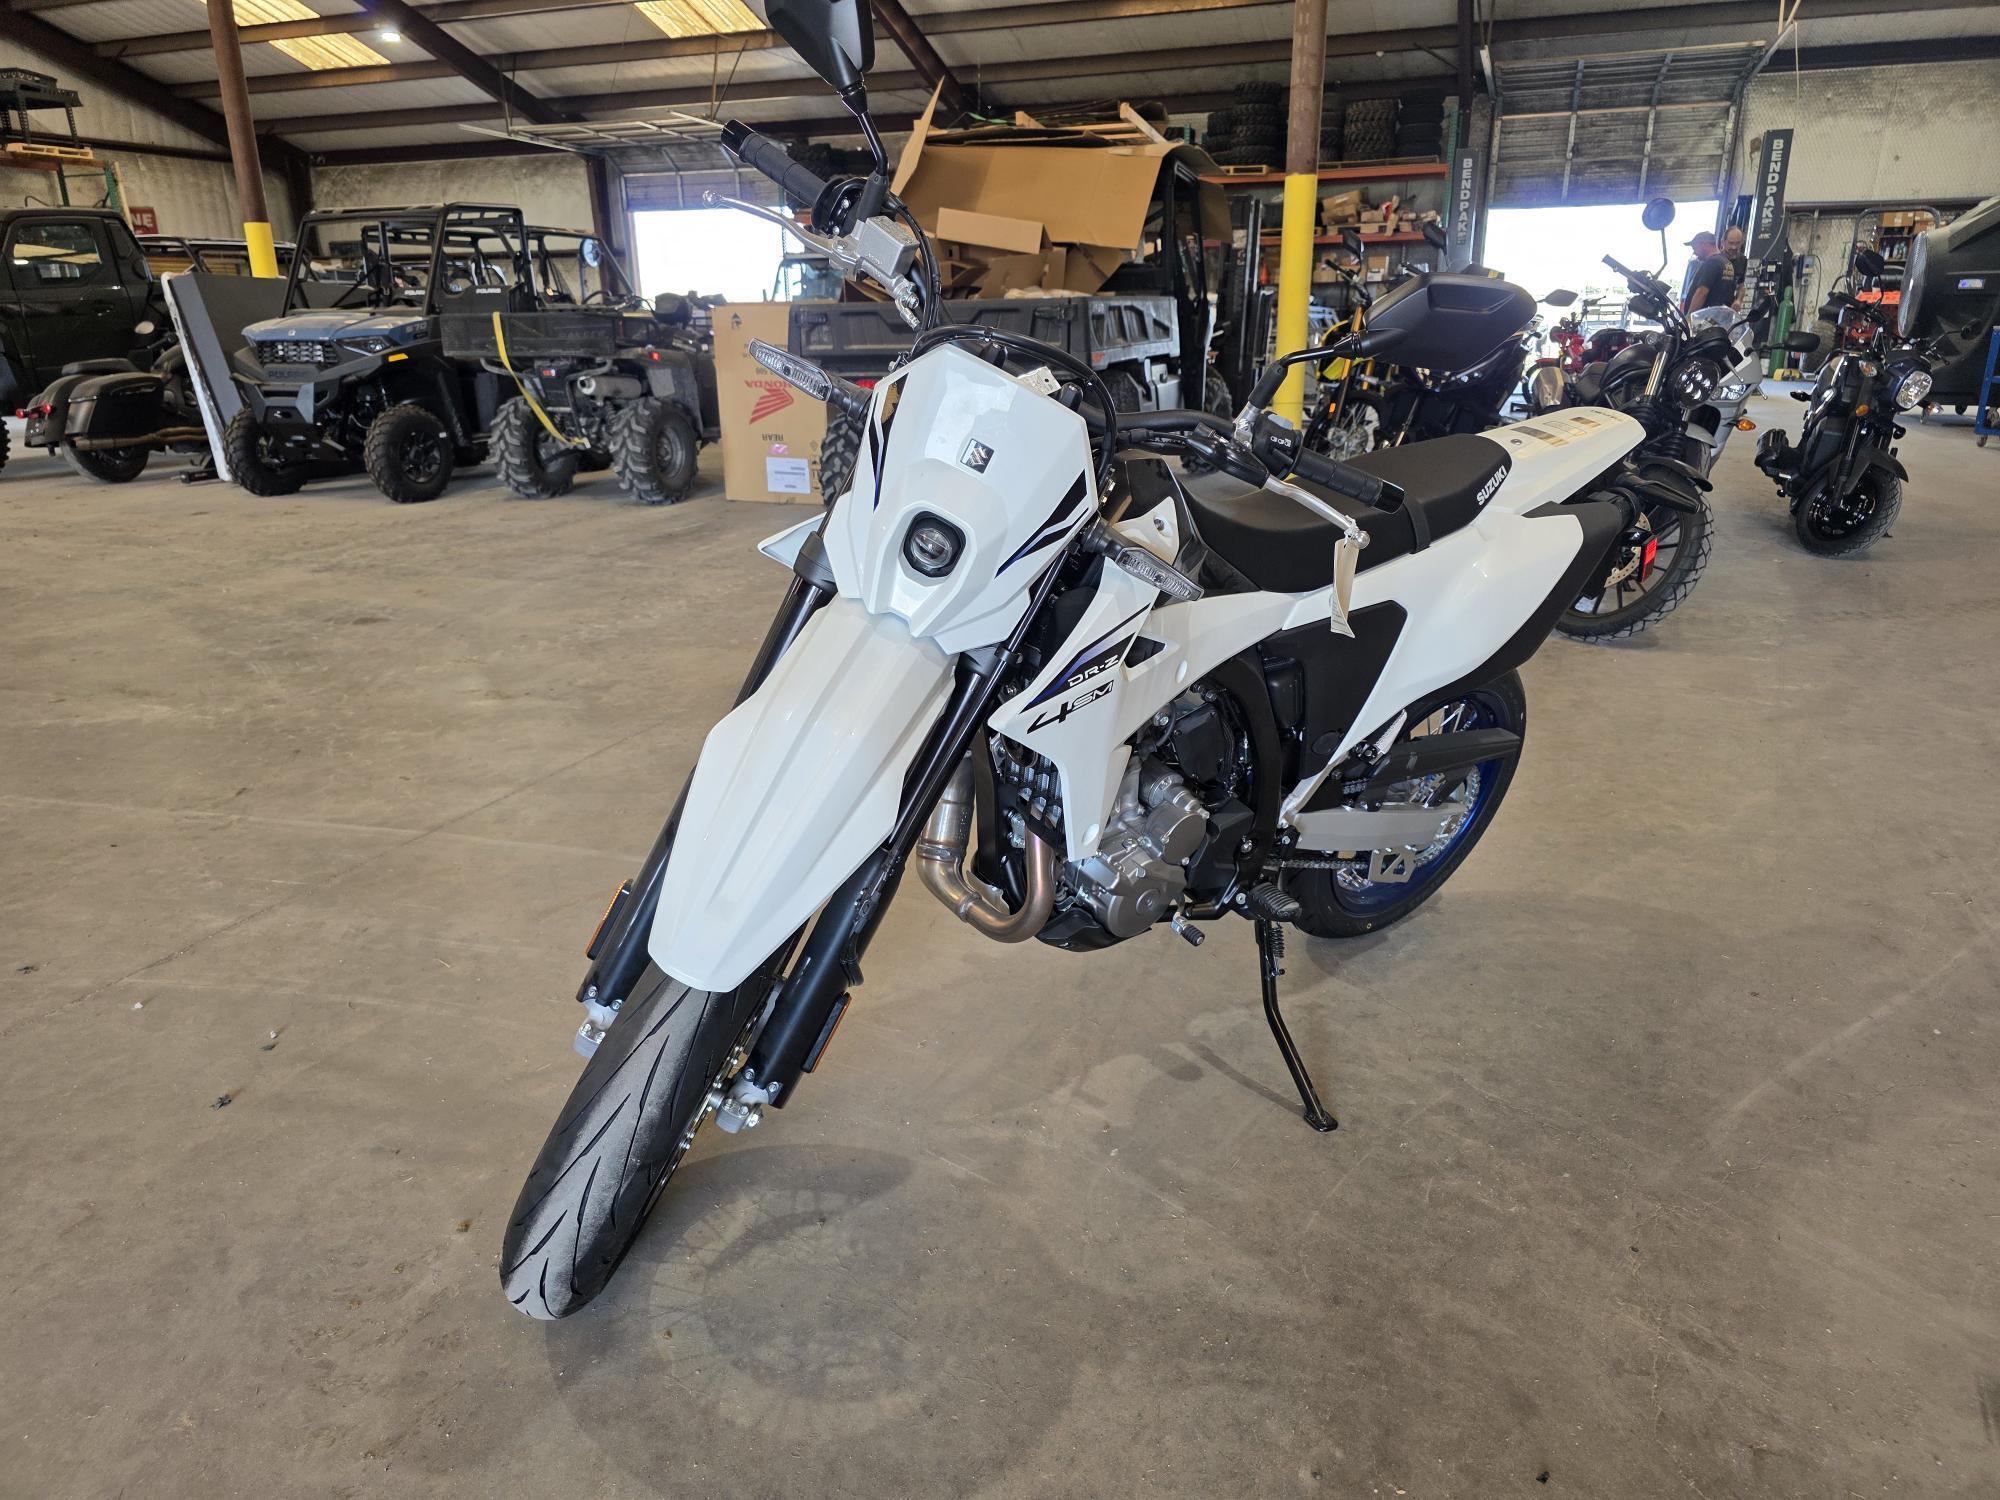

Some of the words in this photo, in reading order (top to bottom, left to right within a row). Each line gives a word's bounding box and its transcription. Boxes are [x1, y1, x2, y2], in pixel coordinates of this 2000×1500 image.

[1457, 158, 1473, 231] BENDPAK
[1763, 139, 1784, 218] BENDPAK
[762, 433, 784, 441] REAR
[1476, 465, 1507, 506] SUZUKI
[1067, 654, 1119, 687] DR-Z
